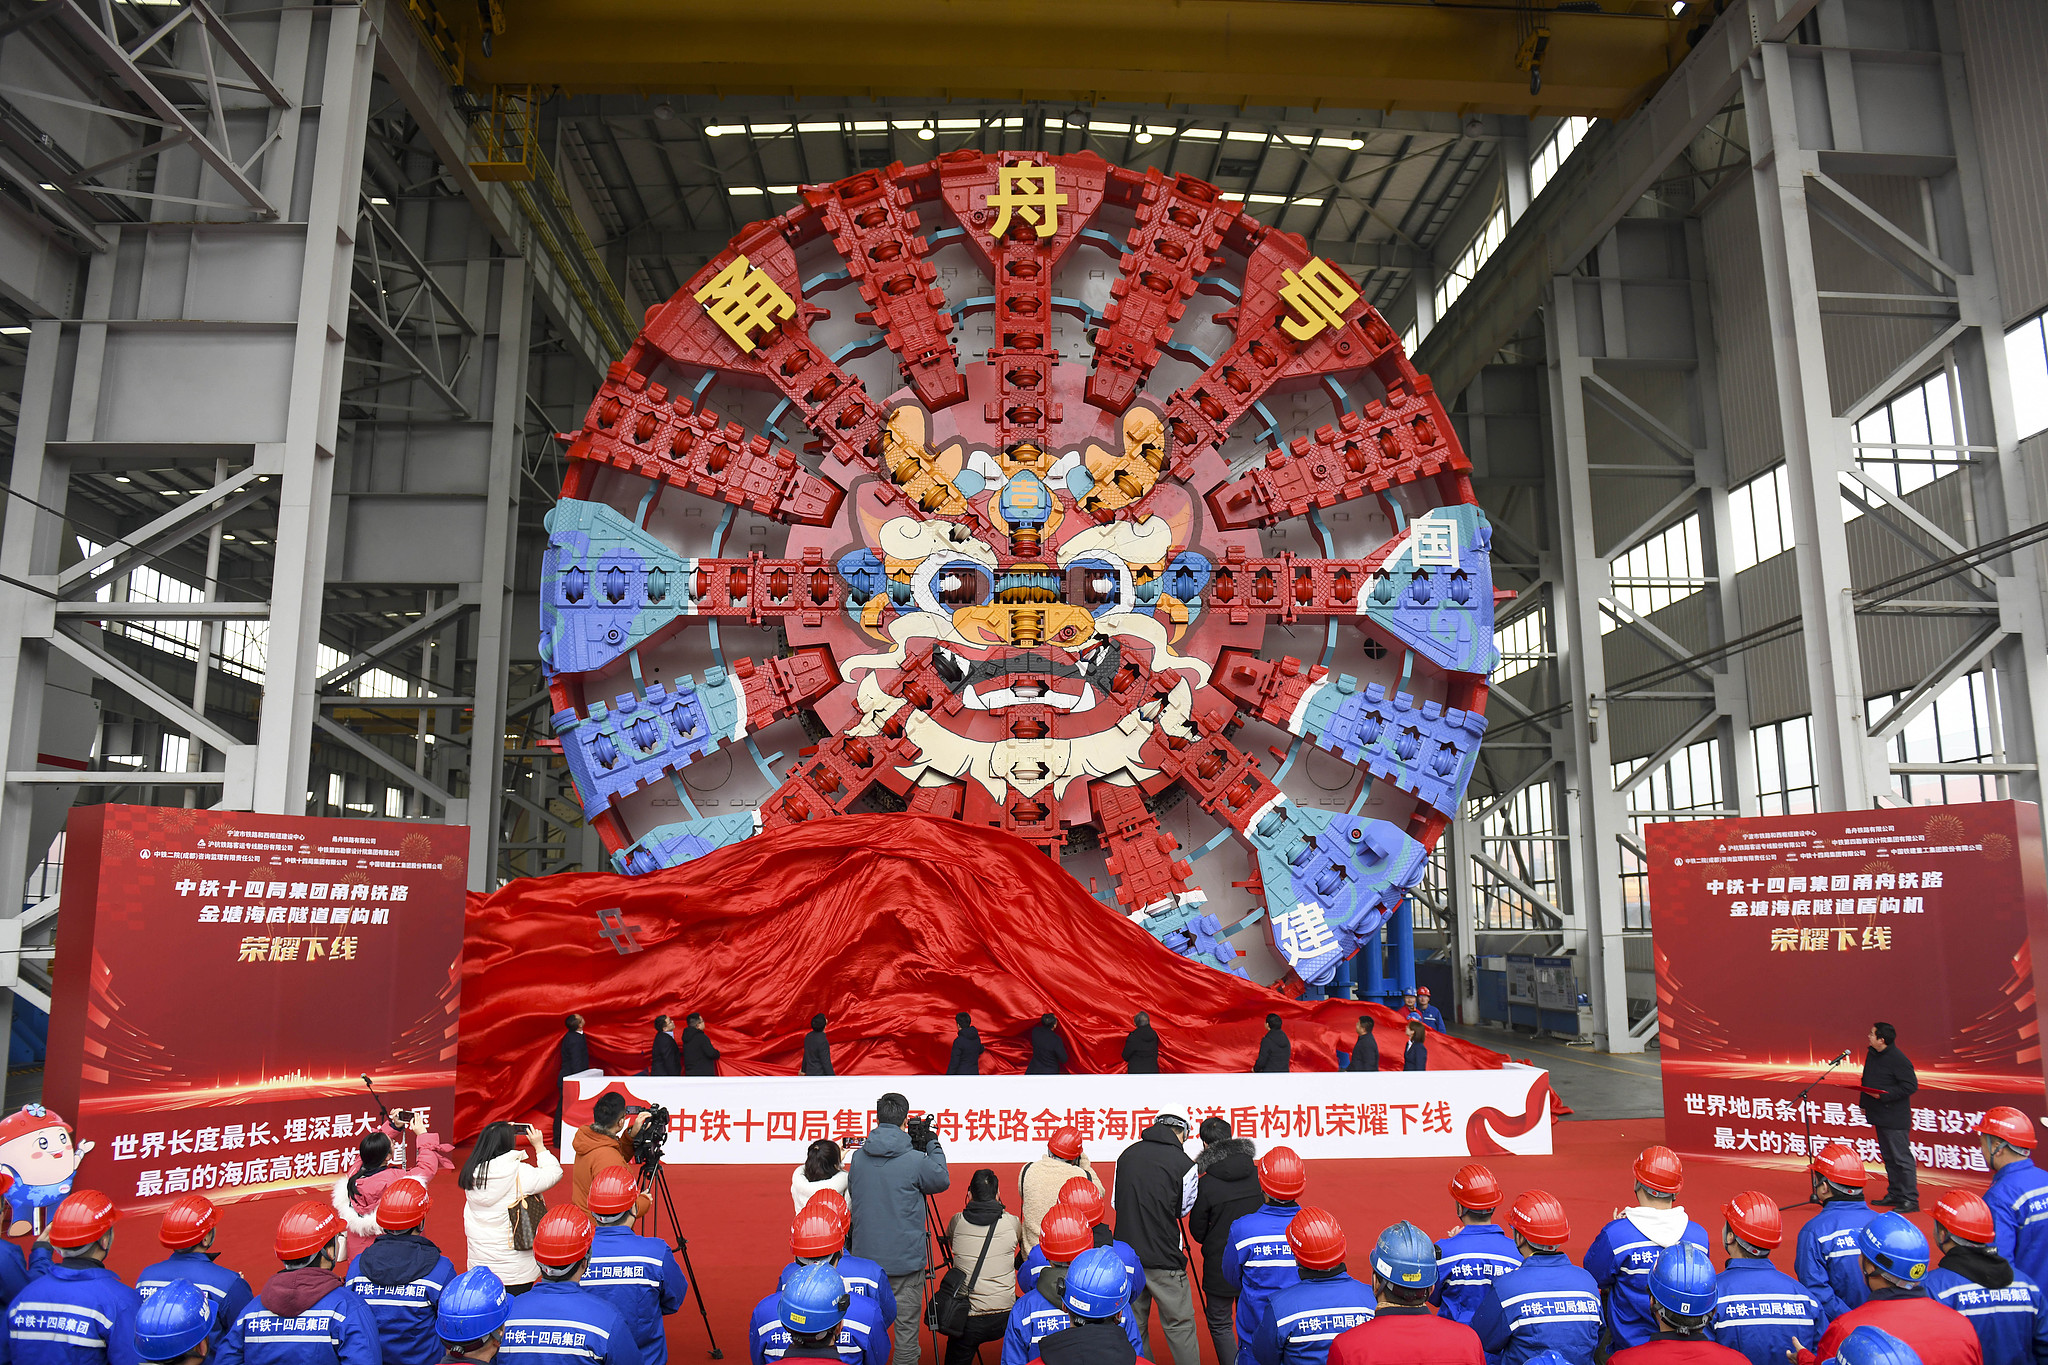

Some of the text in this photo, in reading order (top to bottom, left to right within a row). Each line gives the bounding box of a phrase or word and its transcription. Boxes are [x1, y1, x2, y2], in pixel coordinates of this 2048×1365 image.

[694, 160, 1360, 353] 甬 舟 号
[1409, 517, 1463, 569] 国
[284, 856, 348, 867] 中铁十四局集团有限公司
[1800, 849, 1867, 860] 中铁十四局集团有限公司
[175, 878, 410, 902] 中铁十四局集团甬舟铁路
[1706, 871, 1944, 896] 中铁十四局集团甬舟铁路
[197, 905, 391, 925] 金塘海底隧道盾构机
[1729, 896, 1925, 918] 金塘海底隧道盾构机
[1273, 902, 1344, 967] 建
[1770, 926, 1892, 952] 荣耀下线
[237, 936, 359, 963] 荣耀下线
[110, 1106, 432, 1161] 世界长度最长、埋深最大、压
[136, 1141, 408, 1198] 最高的海底高铁盾构道
[581, 1266, 644, 1279] 铁十四局集团
[355, 1283, 426, 1298] 中铁十四局集团
[1959, 1287, 2031, 1305] 中铁十四局集团
[1520, 1300, 1598, 1317] 中铁十四局集团
[1725, 1301, 1806, 1318] 中铁十四局集团
[14, 1315, 90, 1335] 中铁十四局集团
[248, 1317, 330, 1333] 中铁十四局集团
[505, 1329, 586, 1347] 中铁十四局集团
